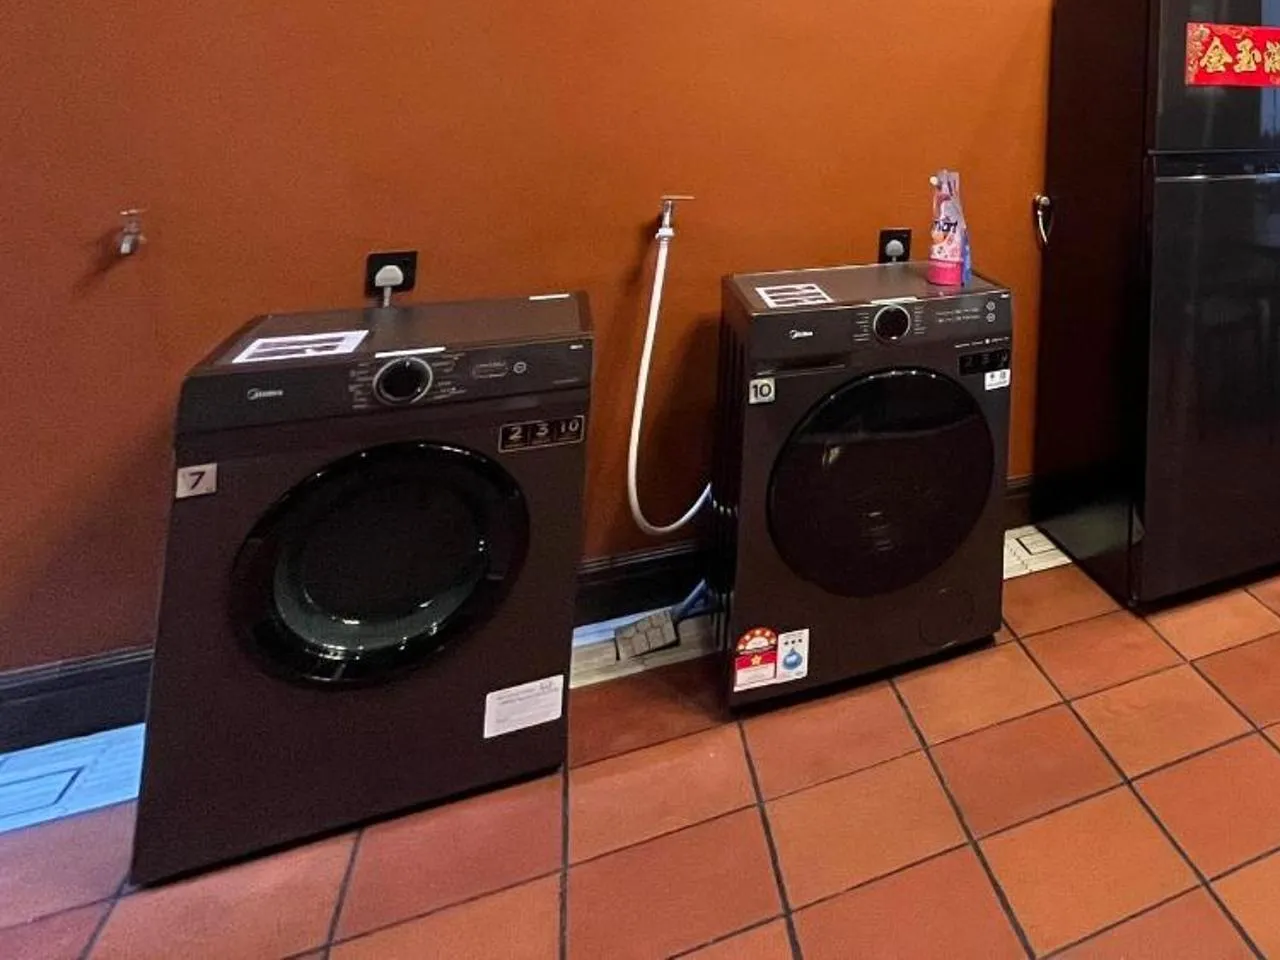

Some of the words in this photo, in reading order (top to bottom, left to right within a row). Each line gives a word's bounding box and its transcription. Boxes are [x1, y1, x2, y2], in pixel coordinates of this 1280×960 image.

[752, 383, 772, 398] 10
[508, 426, 523, 440] 2
[535, 423, 549, 436] 3
[560, 419, 580, 433] 10
[189, 471, 206, 489] 7
